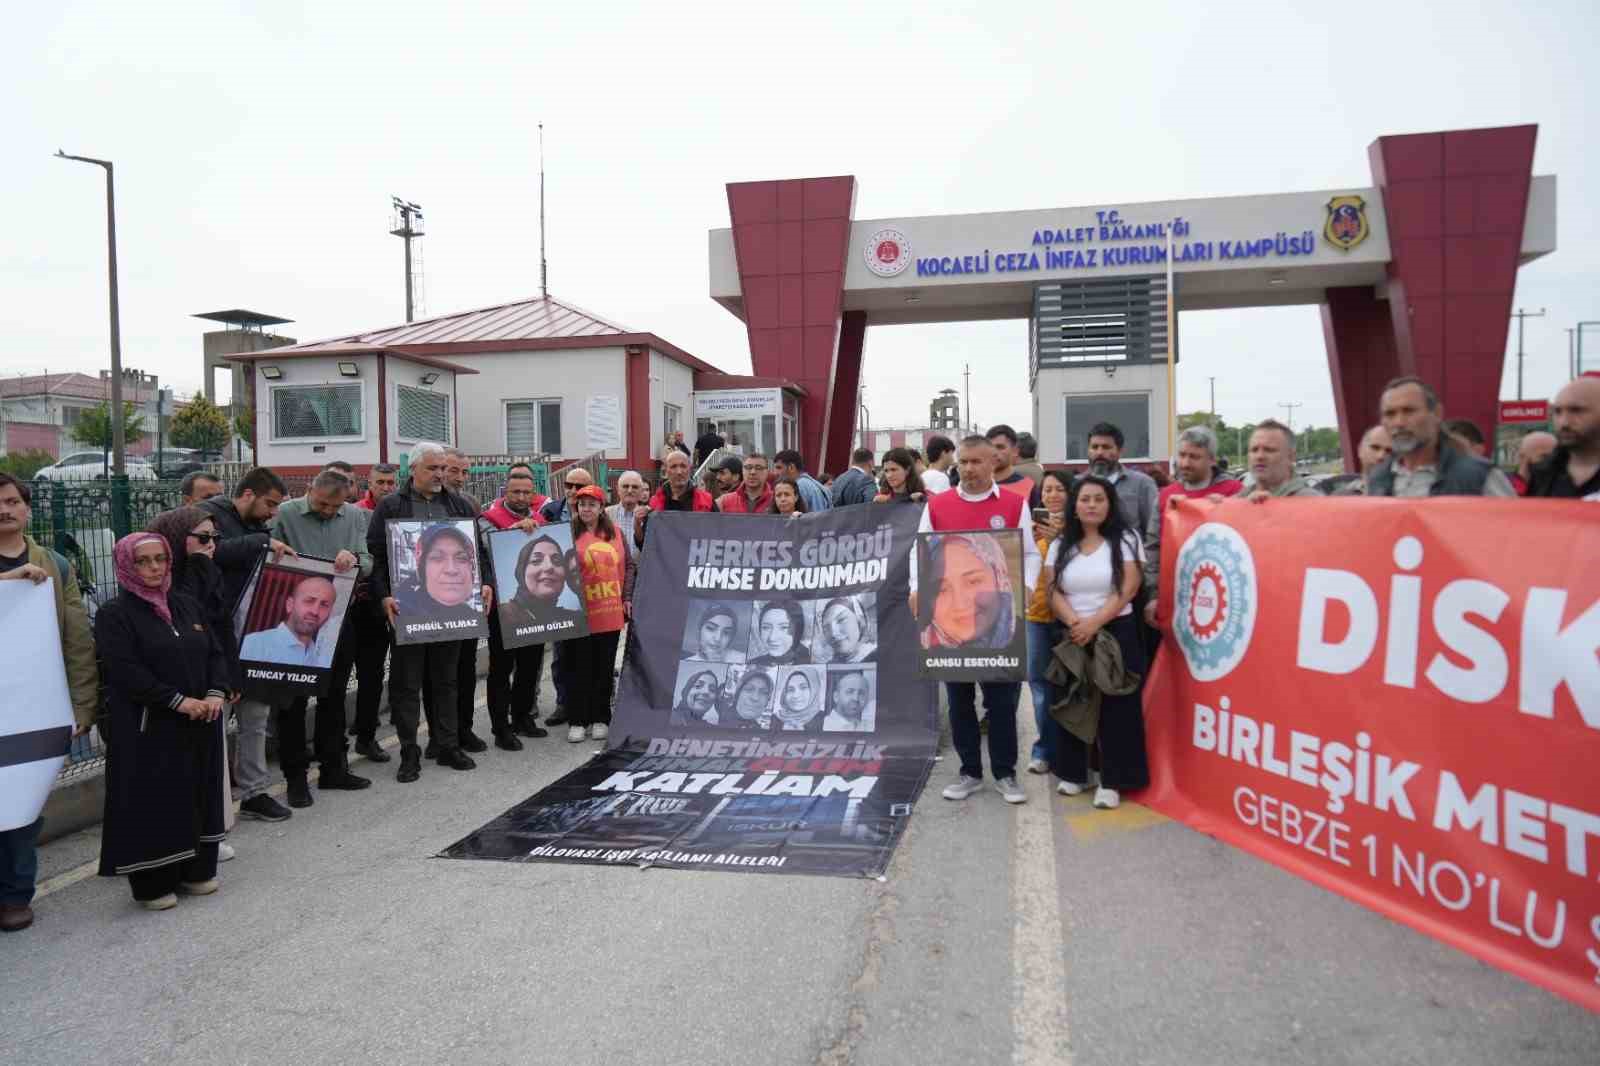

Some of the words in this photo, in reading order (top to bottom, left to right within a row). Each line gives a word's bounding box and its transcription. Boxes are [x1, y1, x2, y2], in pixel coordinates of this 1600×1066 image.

[1032, 226, 1095, 246] ADALET
[1099, 216, 1190, 241] BAKANLĞI
[1095, 209, 1125, 225] T.C.
[916, 249, 990, 277] KOCAELİ
[995, 252, 1040, 272] CEZA
[1045, 246, 1098, 270] İNFAZ
[1103, 241, 1213, 266] KURUMLARI
[1219, 230, 1315, 260] KAMPÜSÜ
[687, 537, 794, 569] HERKES
[800, 523, 893, 563] GÖRDÜ
[687, 562, 755, 591] KİMSE
[759, 557, 888, 591] DOKUNMADI
[405, 620, 443, 634] ŞENGÜL
[444, 619, 479, 630] YILMAZ
[516, 624, 545, 636] HANIM
[1296, 535, 1600, 731] DİSK
[247, 669, 286, 681] TUNCAY
[287, 672, 318, 684] YILDIZ
[926, 658, 962, 668] CANSU
[645, 737, 888, 760] DENETİMSİZLİK
[592, 769, 879, 799] KATLİAM
[1192, 695, 1422, 821] BİRLEŞİK
[1432, 769, 1600, 877] MET
[1232, 786, 1352, 867] GEBZE
[1361, 834, 1378, 877] 1
